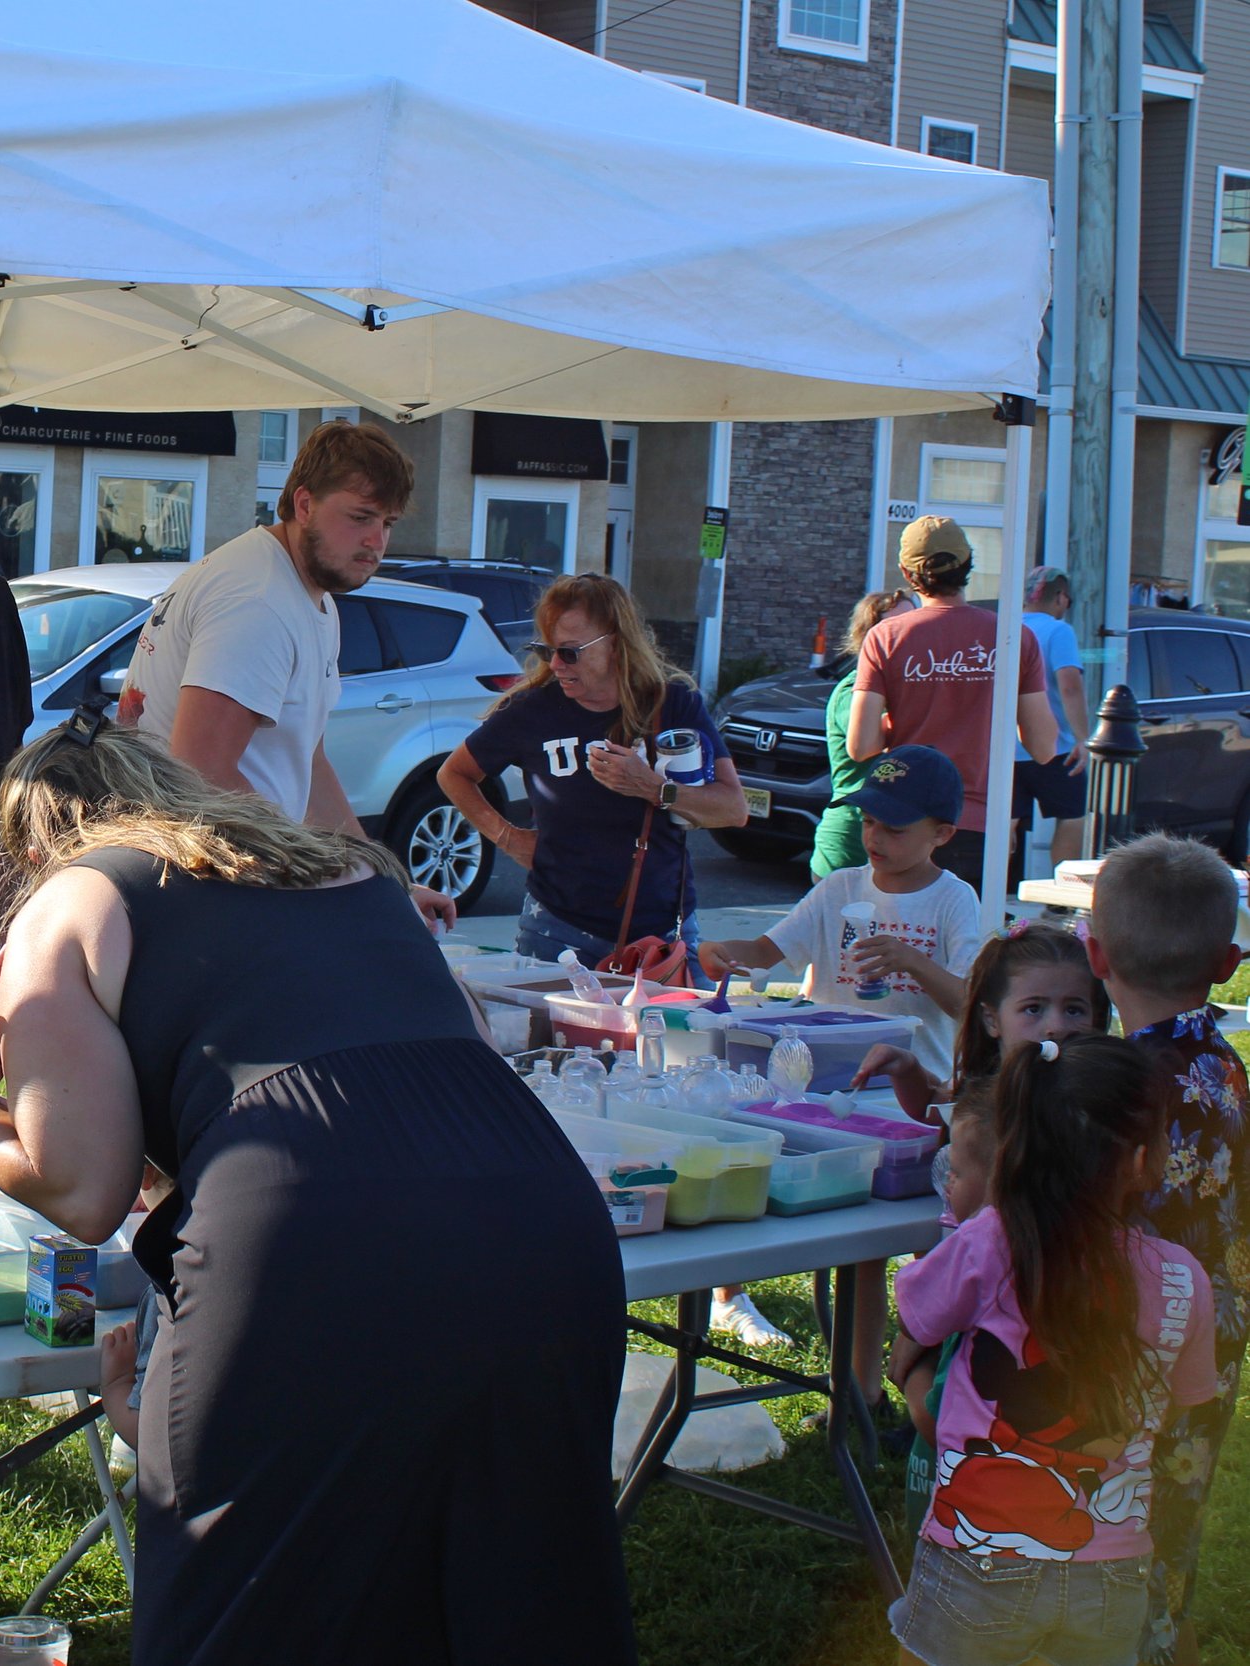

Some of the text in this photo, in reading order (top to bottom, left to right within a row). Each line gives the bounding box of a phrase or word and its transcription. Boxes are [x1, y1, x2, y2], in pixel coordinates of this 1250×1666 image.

[1, 425, 178, 446] CHARCUTERIE FINE FOODS
[888, 503, 916, 519] 4000
[904, 649, 997, 678] Wetland
